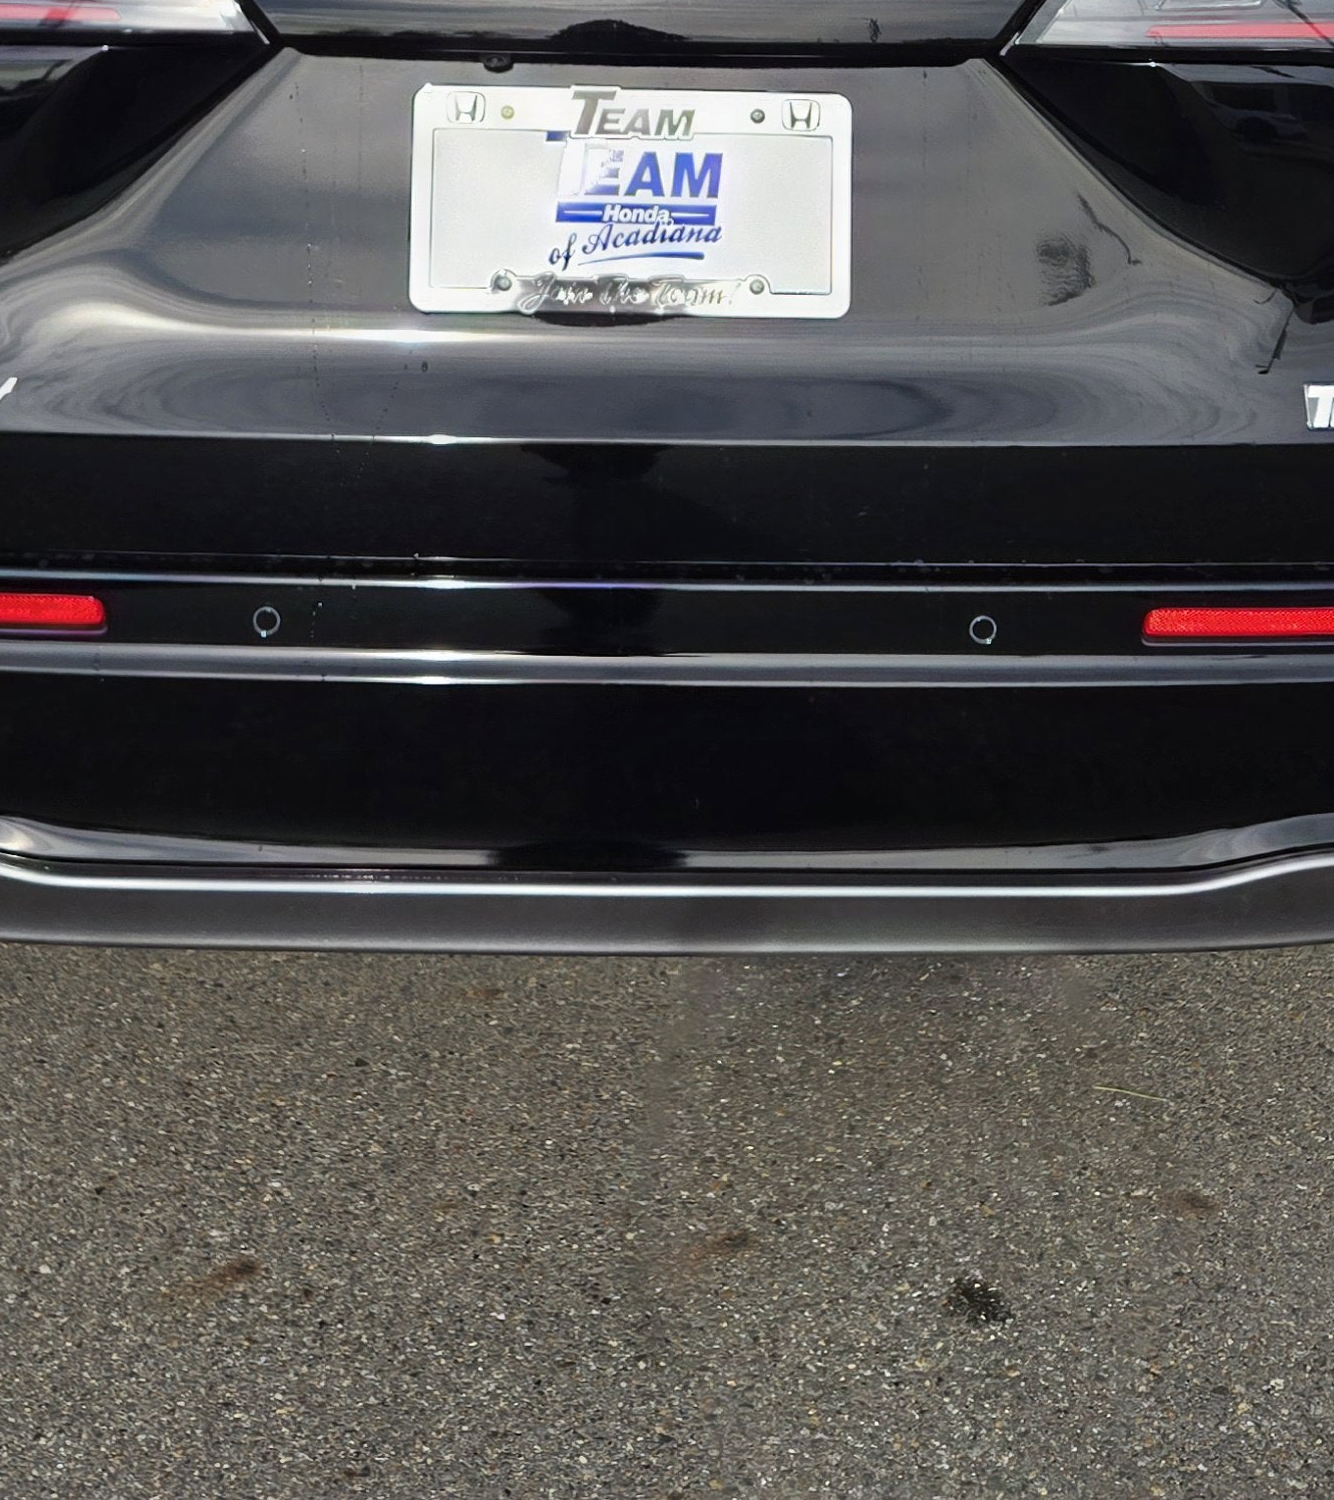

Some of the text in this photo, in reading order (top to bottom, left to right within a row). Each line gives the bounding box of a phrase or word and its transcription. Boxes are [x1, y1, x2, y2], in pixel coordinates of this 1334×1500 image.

[545, 131, 723, 198] EAM
[602, 203, 670, 225] Honda
[548, 221, 723, 271] of Acadiana
